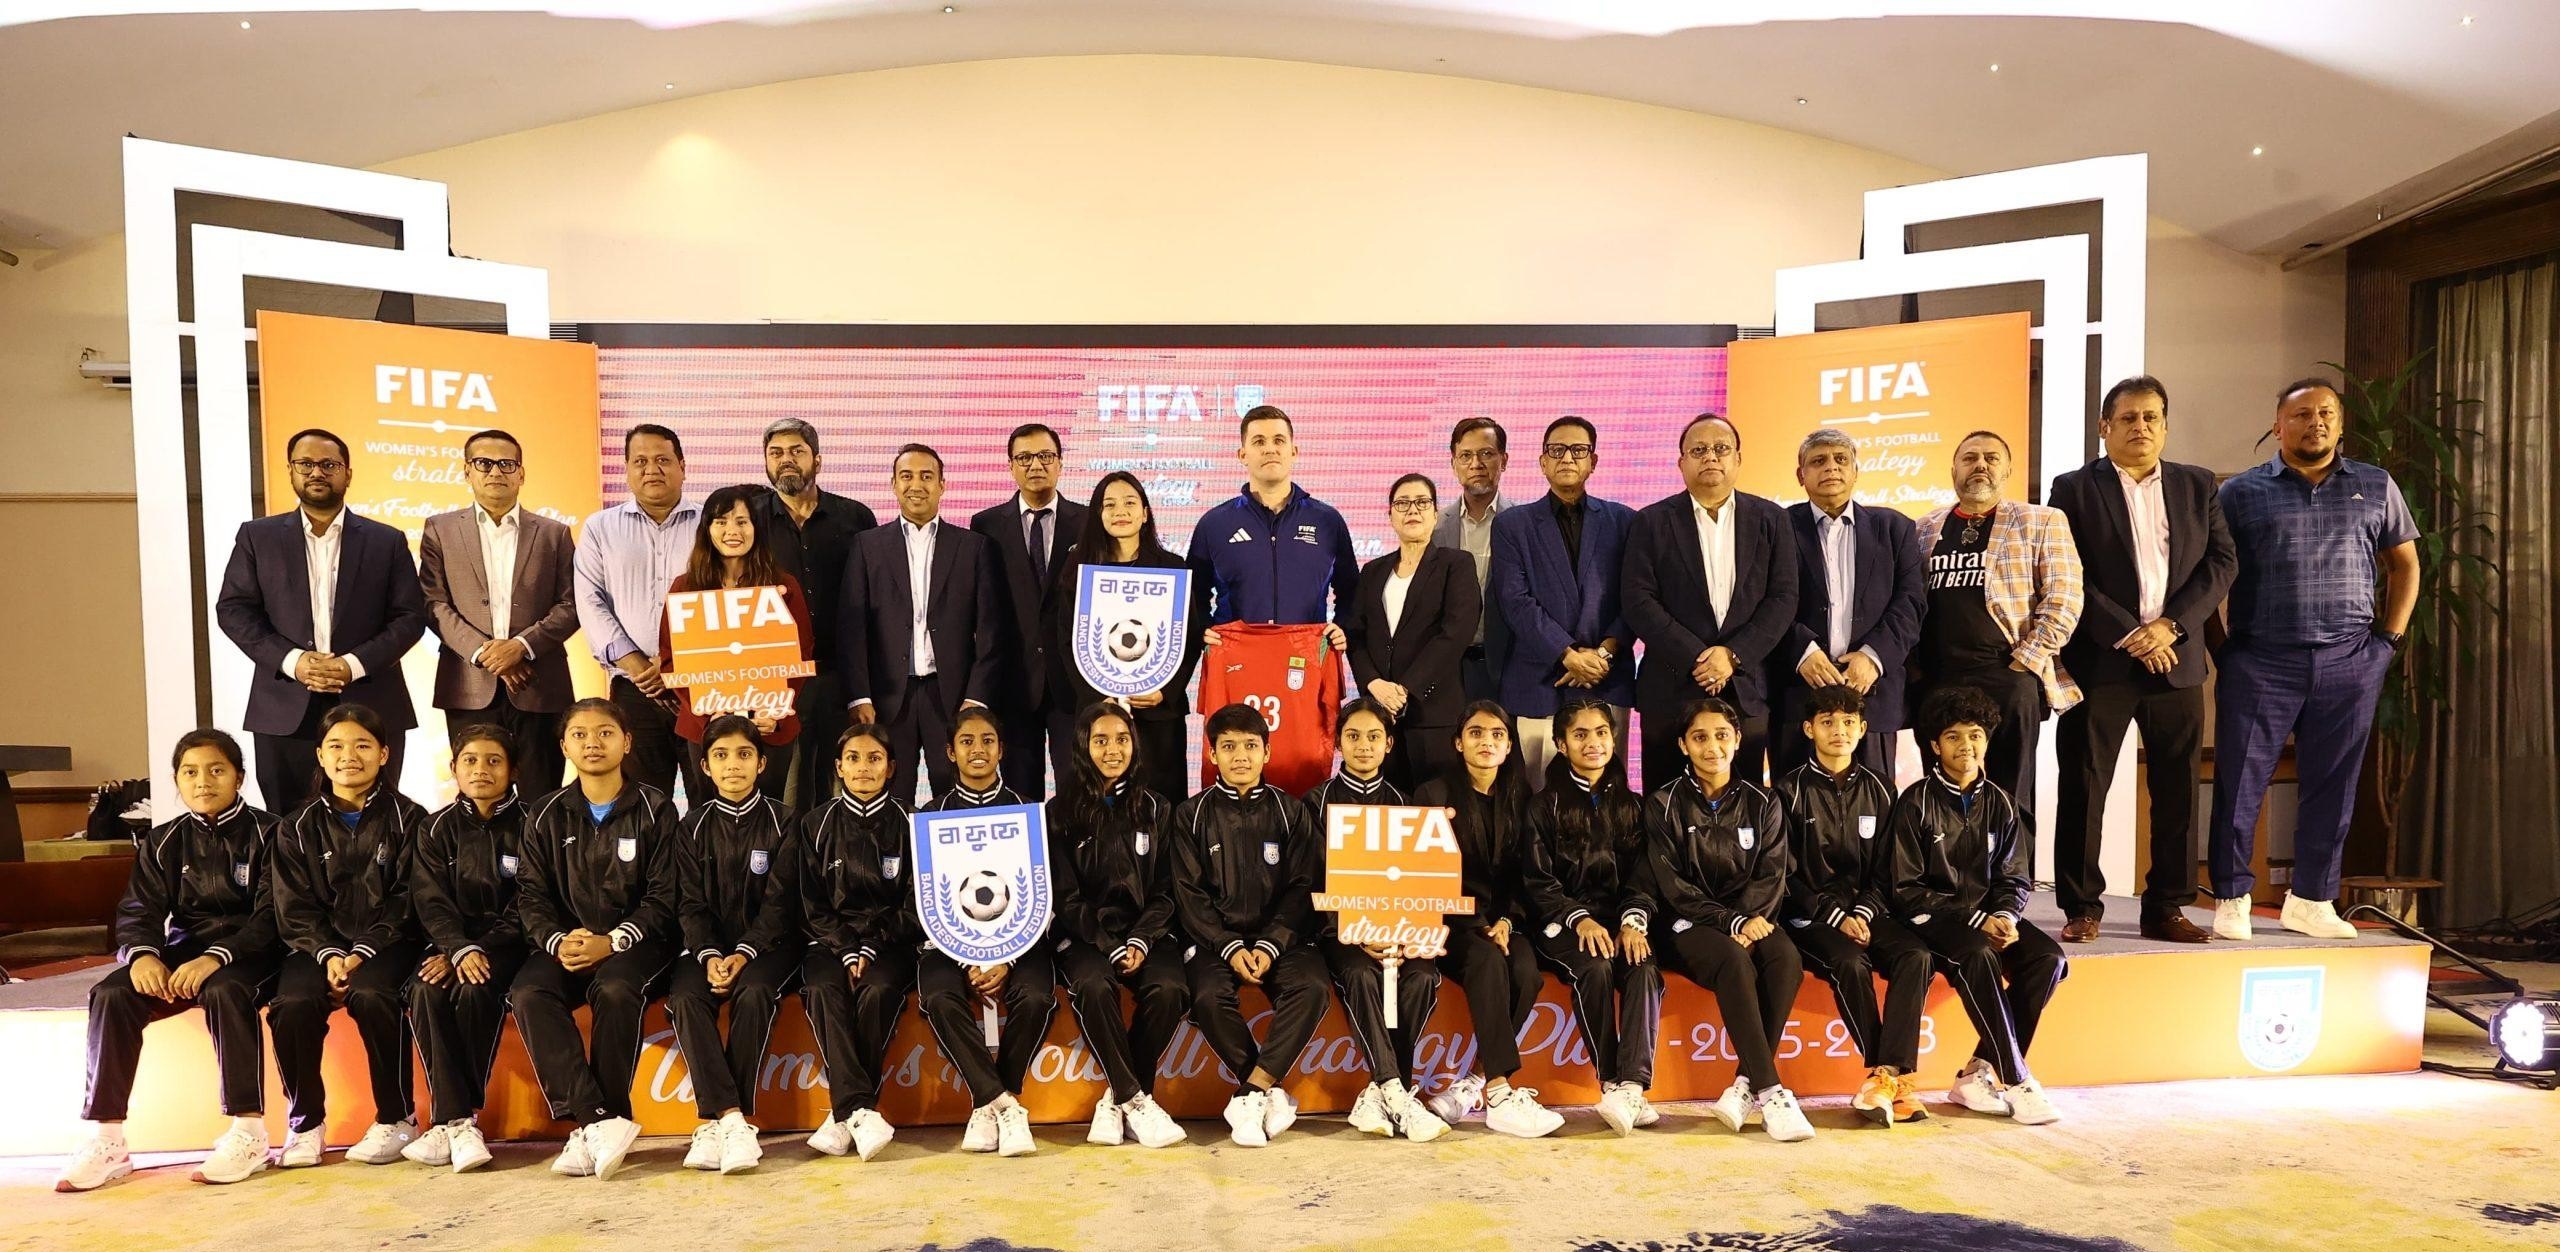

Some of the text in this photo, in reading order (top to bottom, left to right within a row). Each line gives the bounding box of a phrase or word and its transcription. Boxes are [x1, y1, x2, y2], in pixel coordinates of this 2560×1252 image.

[375, 364, 497, 413] FIFA
[1820, 361, 1930, 406] FIFA
[1097, 385, 1204, 422] FIFA
[365, 441, 438, 456] WOMEN'S
[1875, 432, 1942, 448] FOOTBALL
[393, 459, 474, 492] strate
[1856, 449, 1927, 477] ategy
[1929, 550, 1987, 572] mirat
[1945, 569, 1986, 588] BETTE
[668, 587, 794, 634] FIFA
[1078, 614, 1184, 693] BANGLADESH FOOTBALL FEDERATION
[664, 661, 816, 687] WOMEN'S FOOTBALL
[692, 684, 796, 719] strategy
[1329, 806, 1459, 853] FIFA
[920, 864, 1050, 960] BANGLADESH FOOTBALL FEDERATION
[1314, 895, 1473, 913] WOMEN'S FOOTBALL
[1340, 915, 1450, 958] strategy
[1516, 1002, 1591, 1067] Pl
